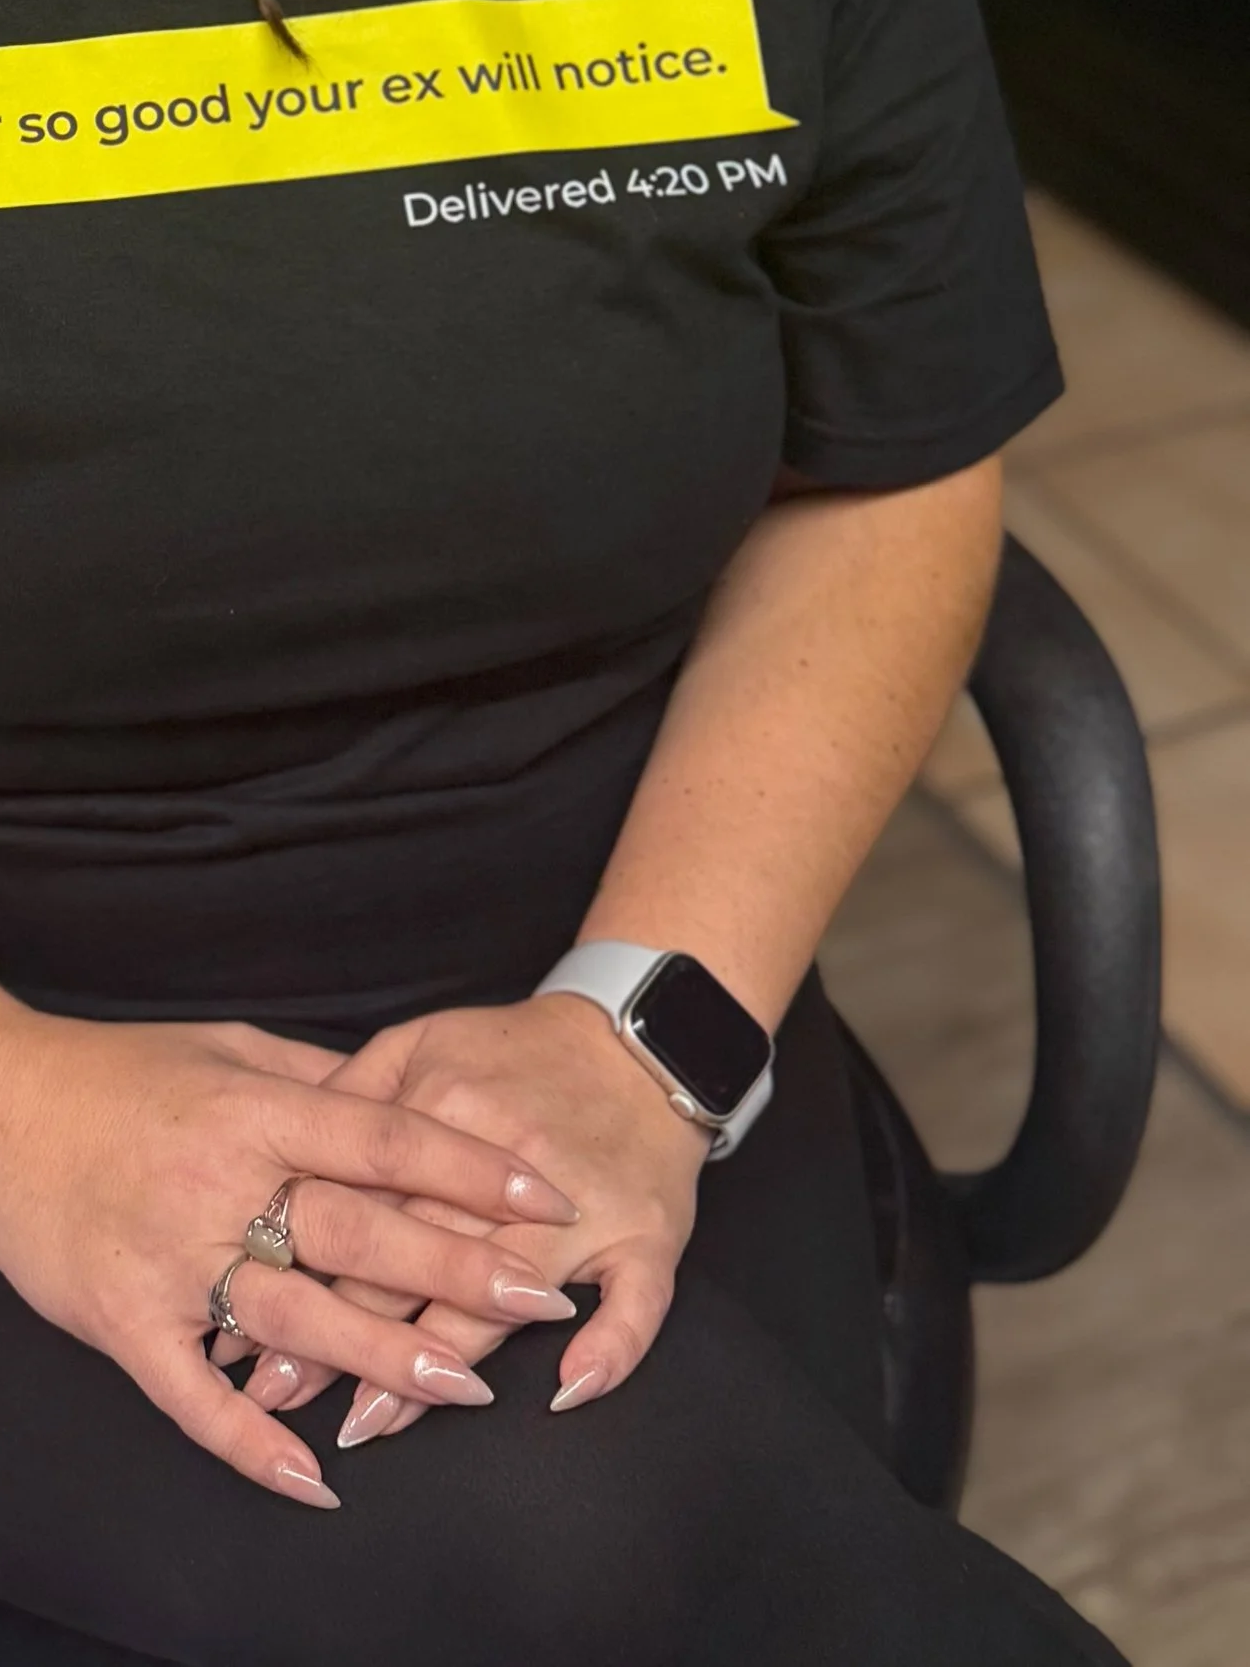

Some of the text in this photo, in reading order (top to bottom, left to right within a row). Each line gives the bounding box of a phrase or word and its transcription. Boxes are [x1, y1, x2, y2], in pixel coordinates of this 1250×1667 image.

[18, 111, 78, 144] so
[95, 83, 231, 146] good
[245, 79, 364, 131] your
[382, 69, 444, 104] ex
[458, 51, 541, 94] will
[553, 42, 727, 91] notice.
[403, 154, 787, 227] Delivered 4:20 PM
